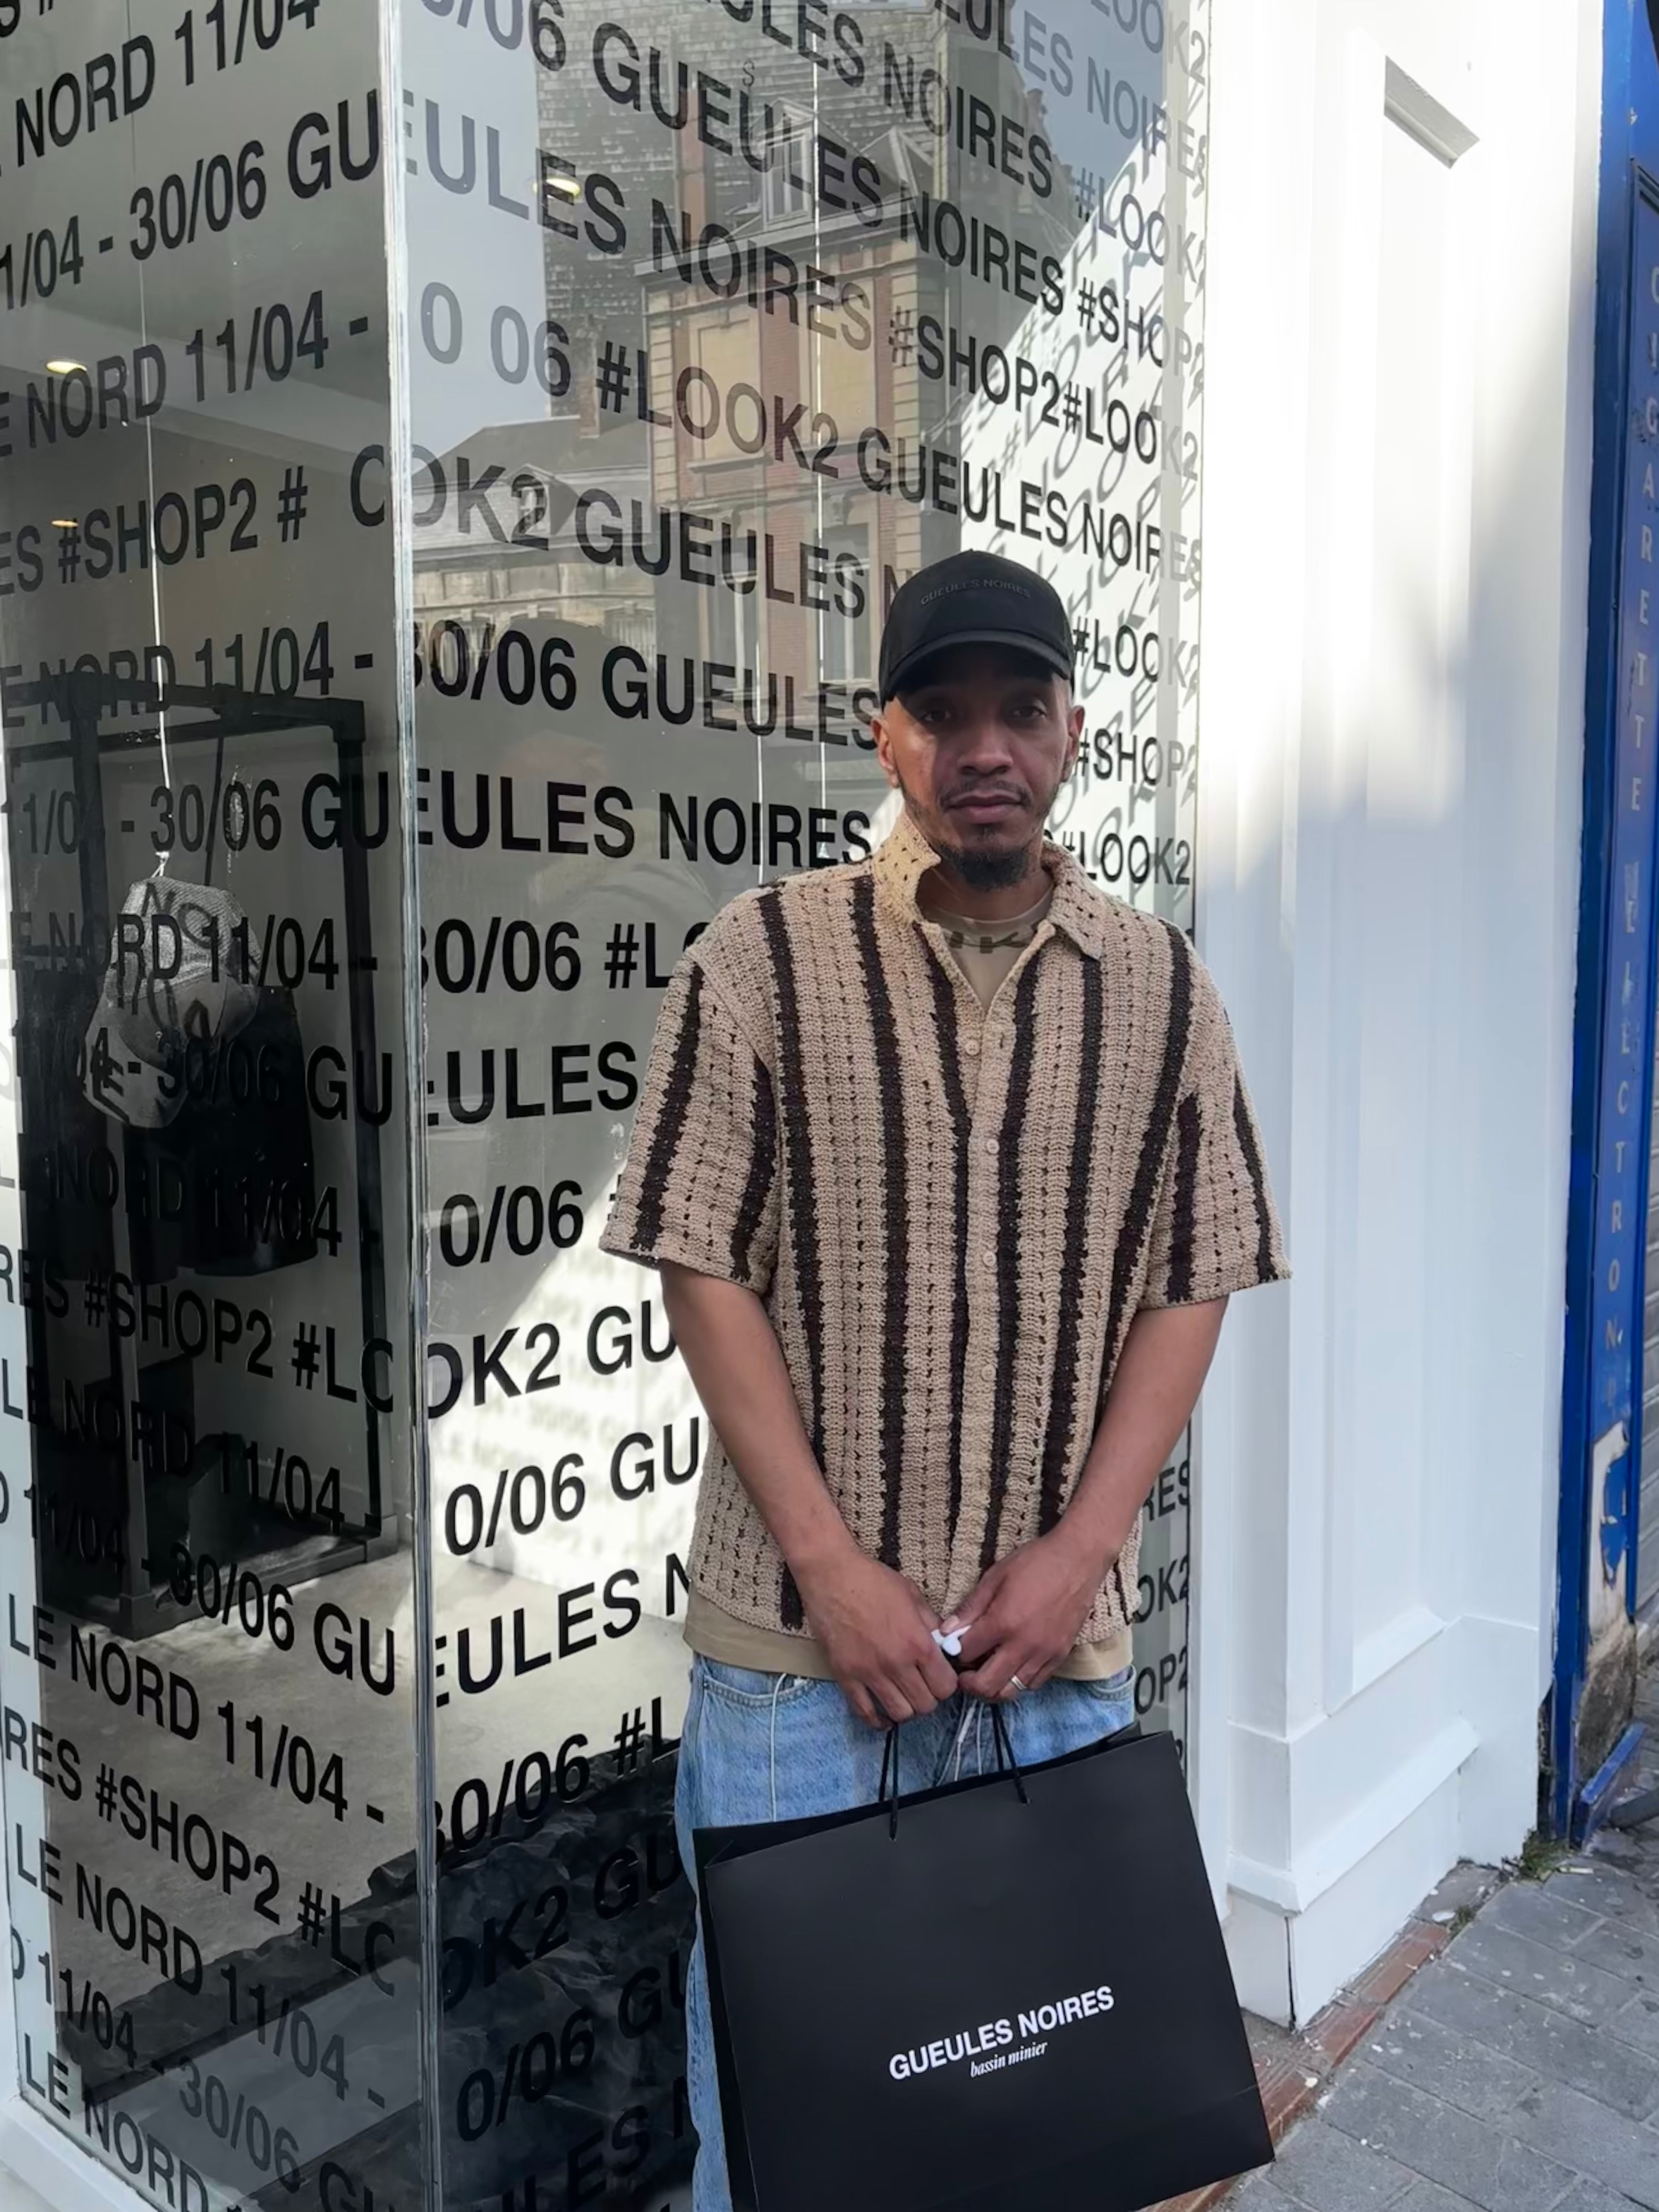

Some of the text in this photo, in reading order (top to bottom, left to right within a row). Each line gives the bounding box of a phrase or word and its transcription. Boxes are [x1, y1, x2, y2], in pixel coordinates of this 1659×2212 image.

[16, 35, 156, 167] NORD
[883, 41, 1052, 198] NOIRES
[130, 140, 267, 261] 30/06
[592, 22, 883, 228] GUEULES
[900, 179, 1064, 315] NOIRES
[651, 198, 872, 351] NOIRES
[27, 344, 167, 448] NORD
[185, 289, 329, 402] 11/04
[596, 341, 839, 479] #LOOK2
[857, 426, 1068, 547] GUEULES
[58, 476, 258, 584] #SHOP2
[575, 488, 865, 619] GUEULES
[40, 645, 177, 725] NORD
[195, 621, 334, 697] 11/04
[601, 646, 878, 751] GUEULES
[150, 778, 282, 852] 30/06
[659, 792, 870, 868] NOIRES
[202, 914, 339, 990] 11/04
[427, 1042, 637, 1126] ULES
[84, 1266, 273, 1378] #SHOP2
[63, 1378, 195, 1477] NORD
[220, 1431, 345, 1535] 11/04
[170, 1541, 294, 1652] 30/06
[9, 1593, 56, 1670] LE
[70, 1623, 199, 1741] NORD
[218, 1700, 348, 1822] 11/04
[96, 1762, 280, 1925] #SHOP2
[16, 1823, 63, 1905] LE
[77, 1862, 203, 1996] NORD
[220, 1962, 349, 2101] 11/04
[38, 1951, 138, 2070] 11/04
[179, 2054, 302, 2194] 30/06
[889, 1985, 1115, 2080] GUEULES NOIRES
[970, 2041, 1048, 2078] bassin minier
[24, 2033, 210, 2212] LE NORD
